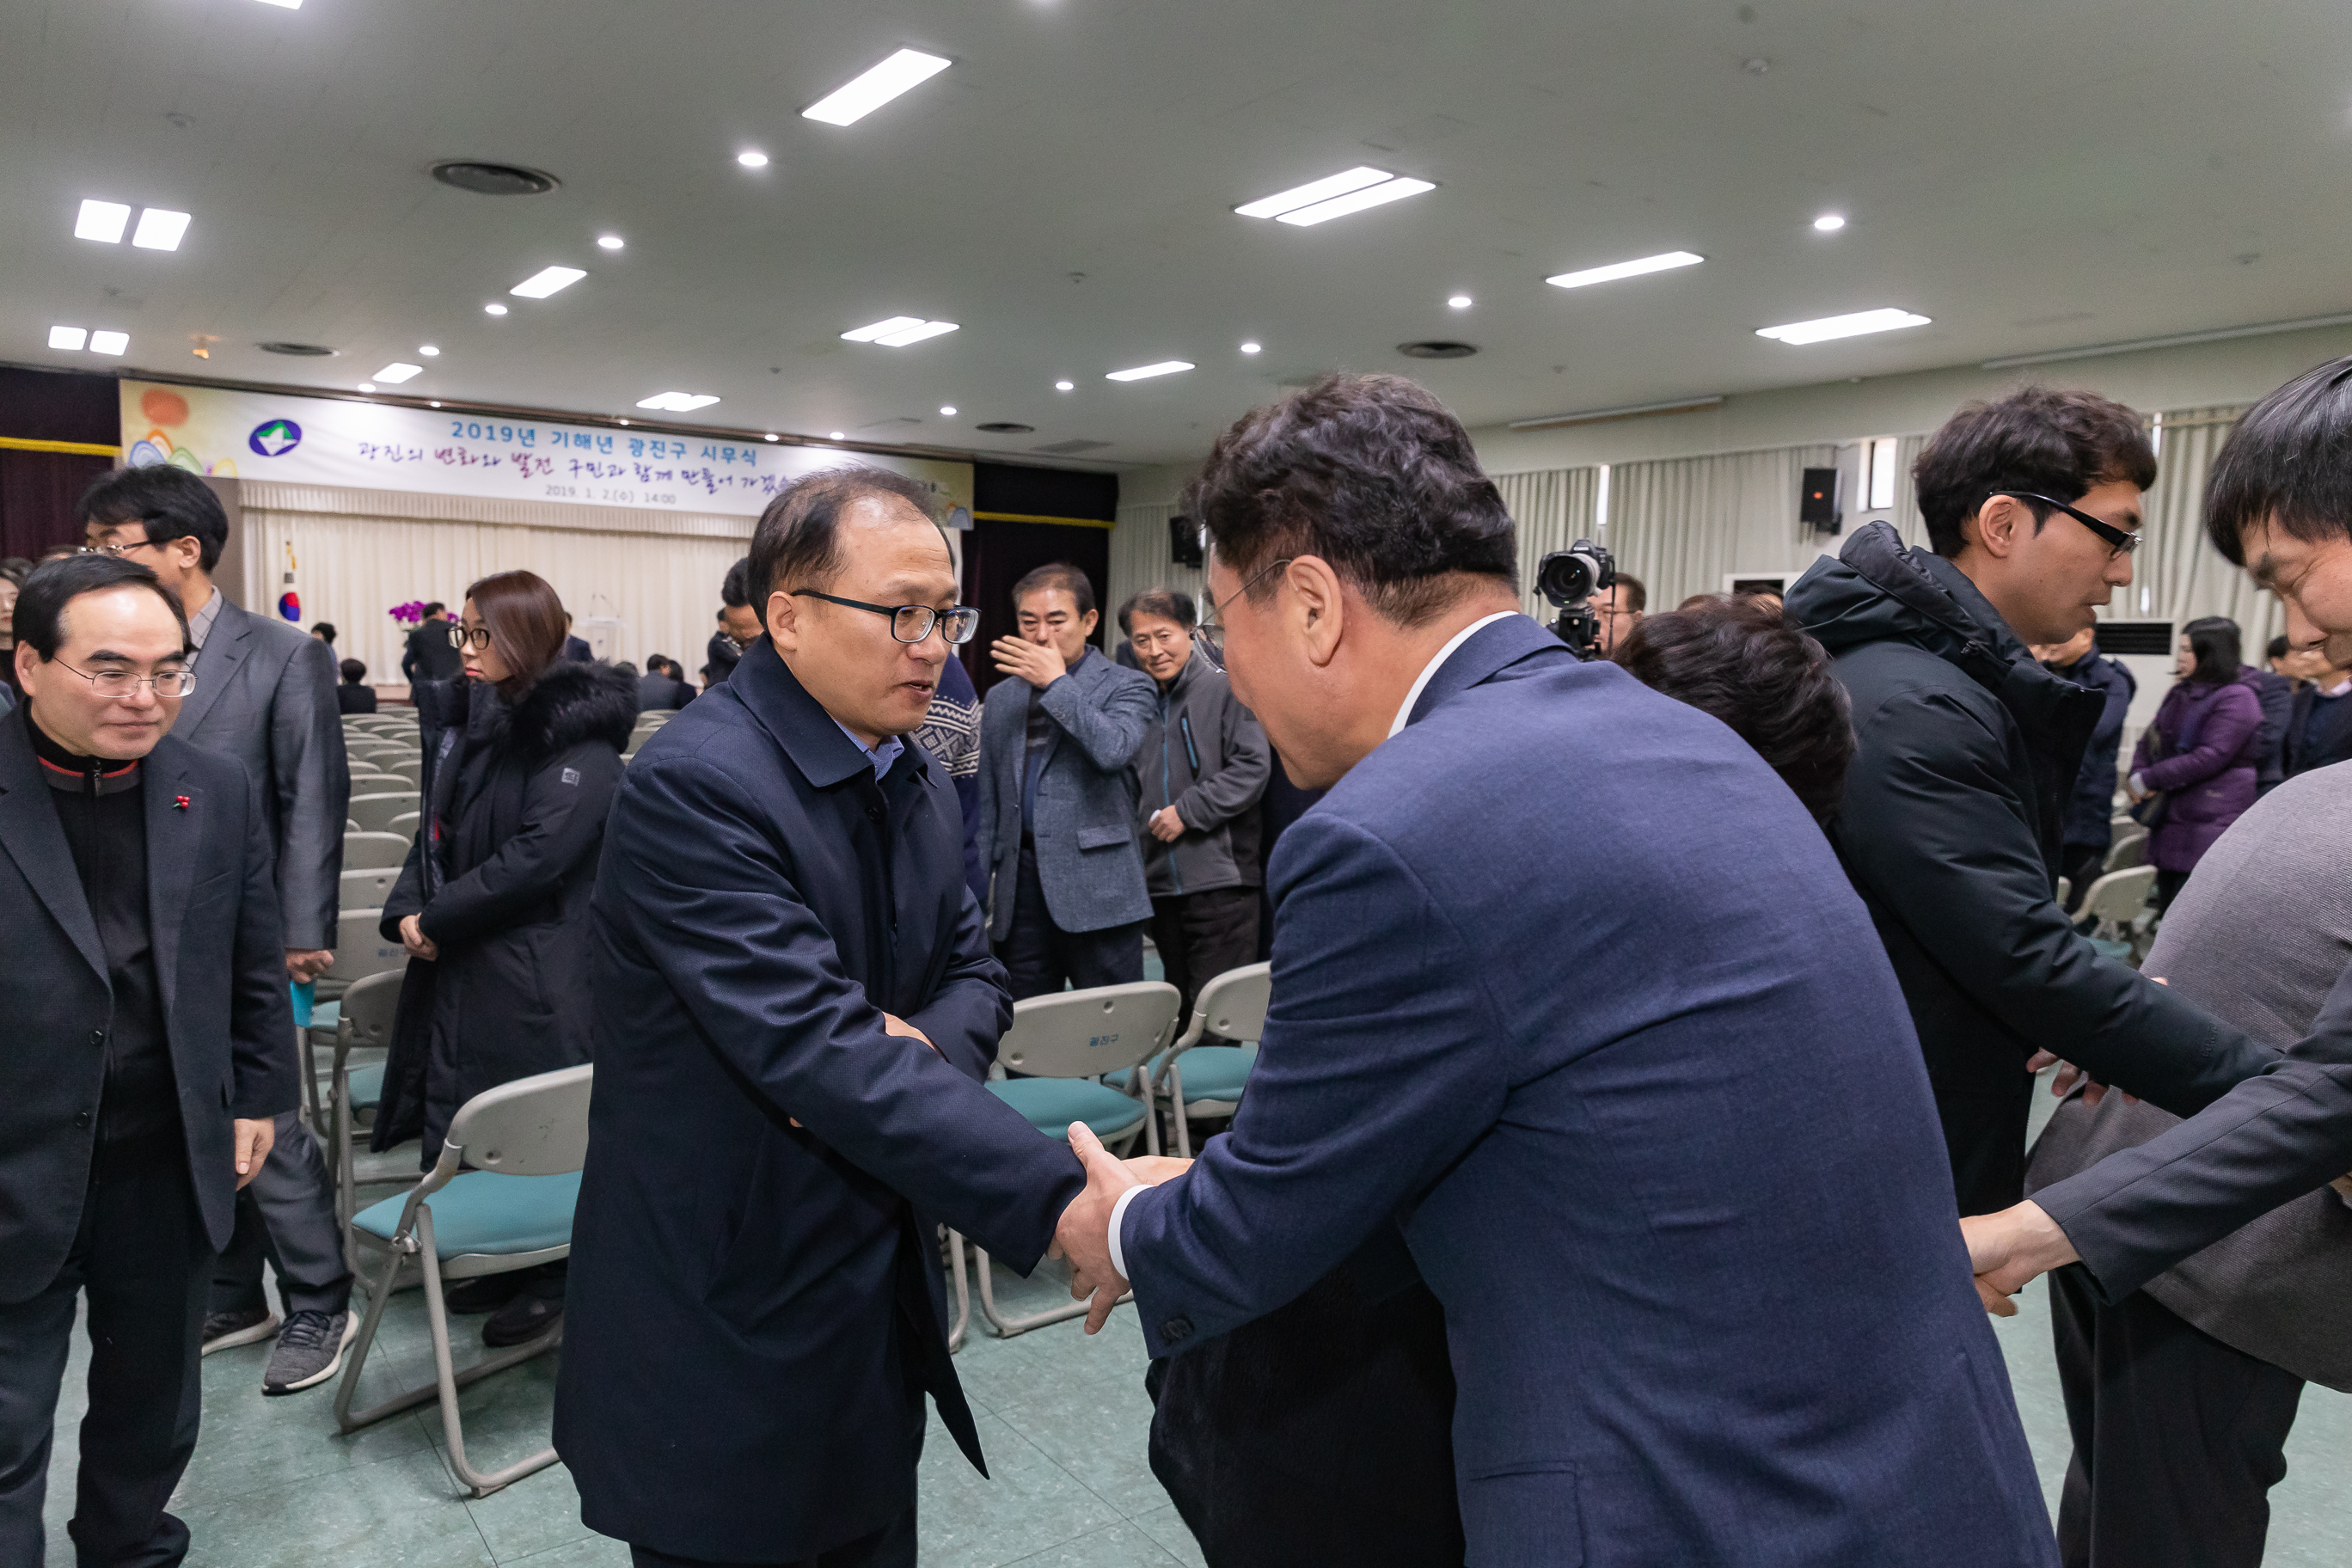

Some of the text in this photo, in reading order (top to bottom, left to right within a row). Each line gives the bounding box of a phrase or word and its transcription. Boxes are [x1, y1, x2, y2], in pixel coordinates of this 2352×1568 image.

[358, 442, 423, 462] 광진의
[434, 446, 501, 467] 변화와
[511, 451, 554, 479] 발전
[568, 458, 626, 479] 구민과
[633, 462, 673, 483] 함께
[681, 467, 733, 495] 만들어
[451, 421, 756, 467] 2019년 기해년 광진구 시무식
